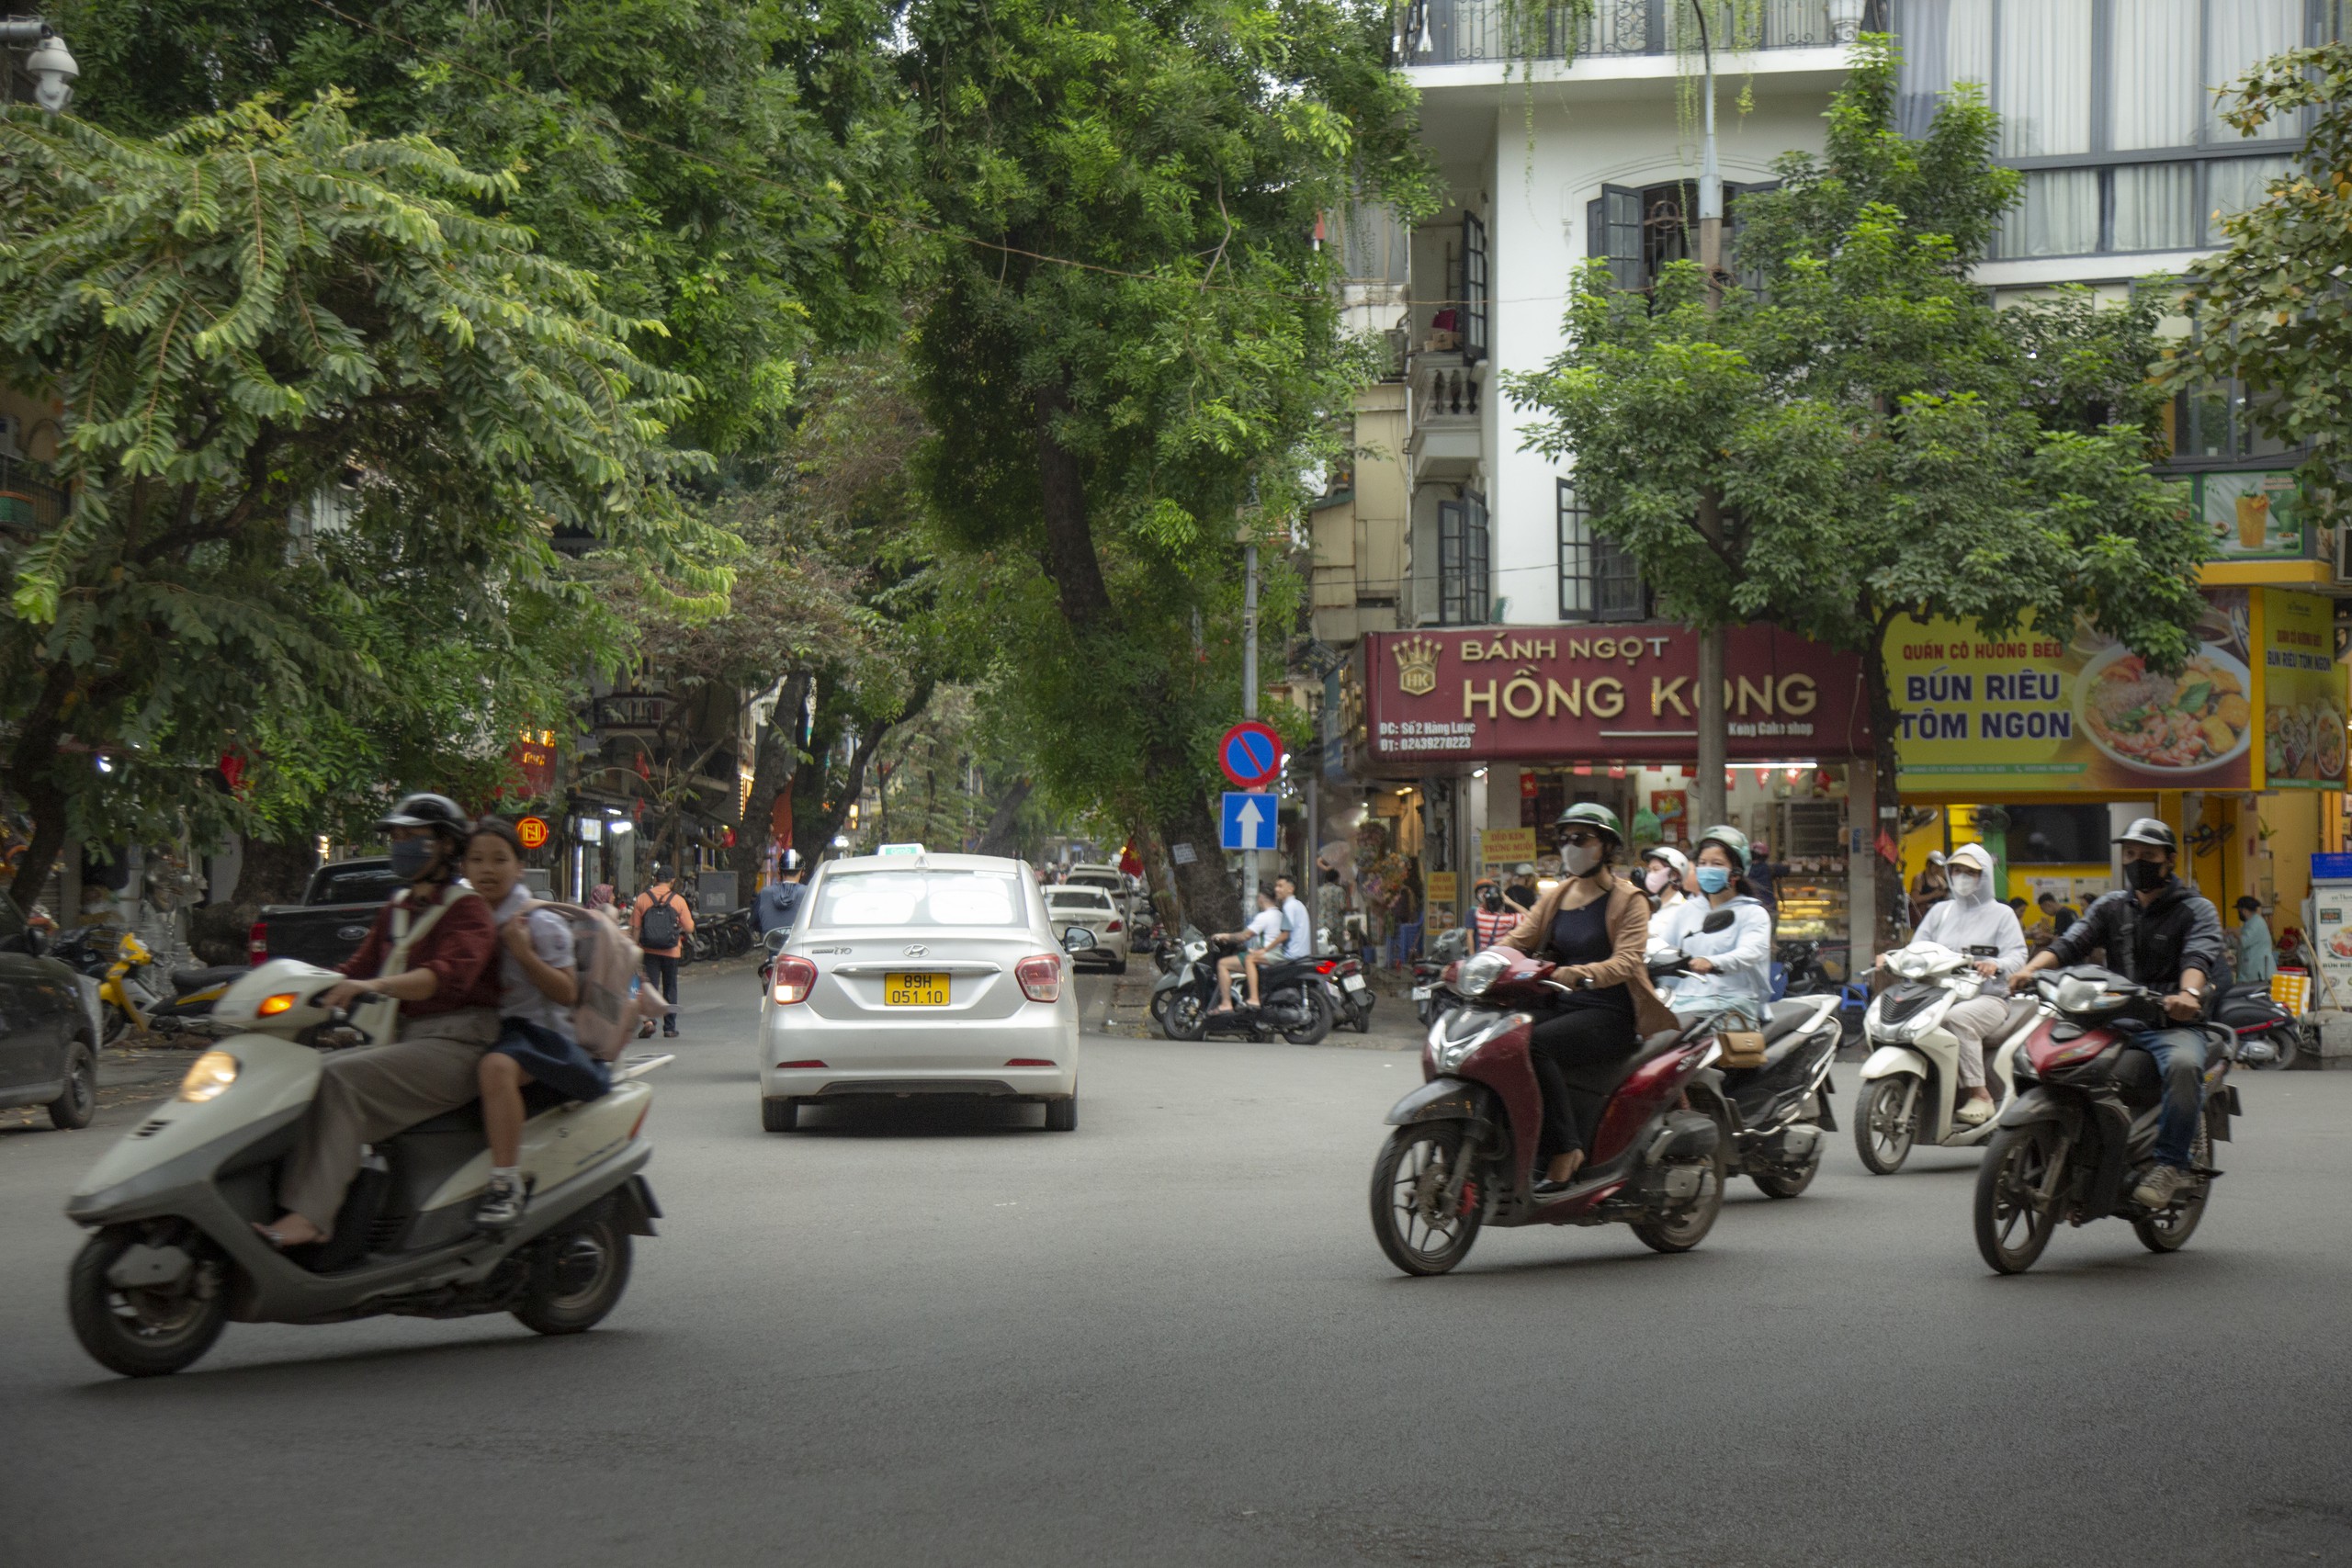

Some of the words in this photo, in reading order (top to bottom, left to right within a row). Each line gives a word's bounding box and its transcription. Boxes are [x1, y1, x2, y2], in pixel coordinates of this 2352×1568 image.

[1461, 632, 1556, 660] BÁNH
[1569, 636, 1669, 666] NGỌT
[1904, 637, 1944, 660] QUÁN
[1406, 673, 1430, 687] HK
[1464, 664, 1624, 718] HỒNG
[1906, 665, 1973, 702] BÚN
[1985, 668, 2060, 701] RIÊU
[1424, 720, 1450, 736] Hàng
[1900, 707, 1968, 739] TÔM
[1981, 711, 2071, 739] NGON
[904, 975, 932, 988] 89H
[892, 990, 943, 1004] 051.10
